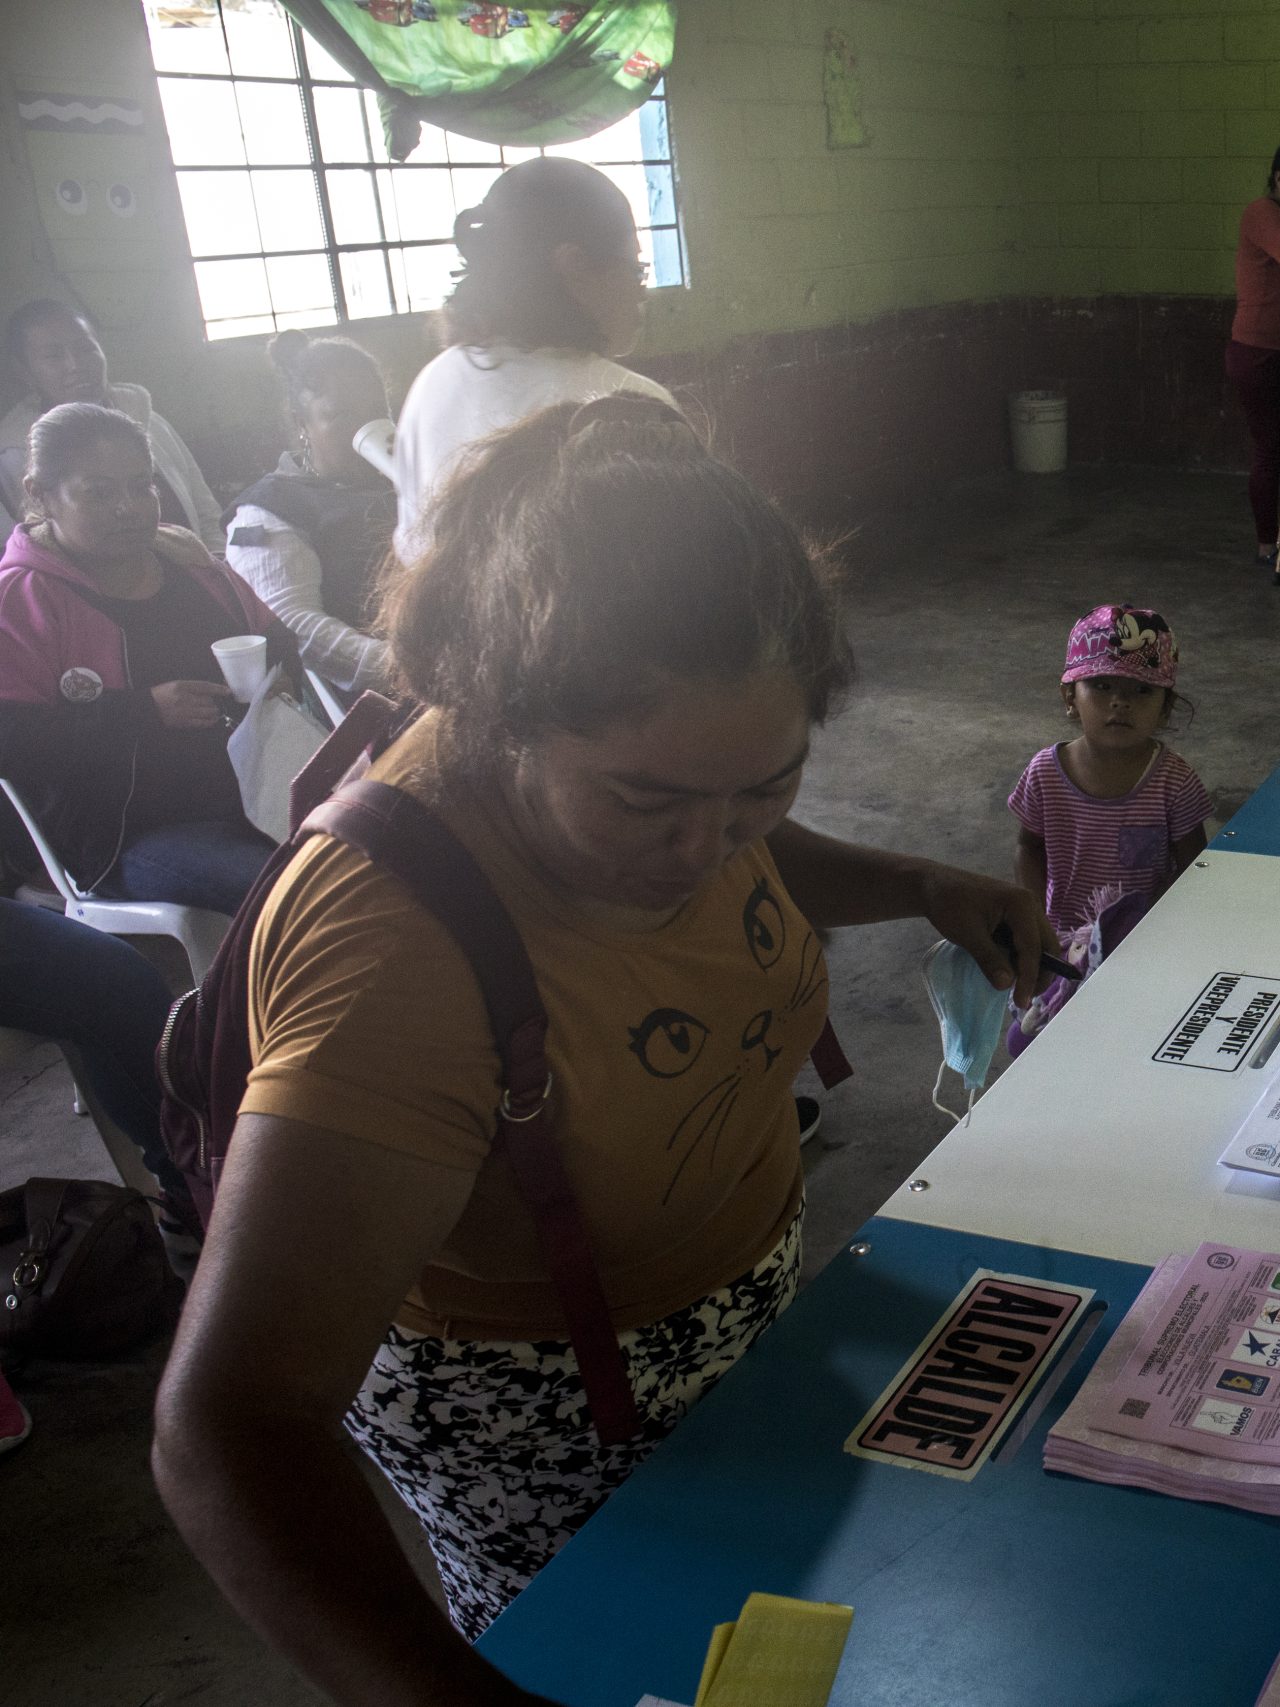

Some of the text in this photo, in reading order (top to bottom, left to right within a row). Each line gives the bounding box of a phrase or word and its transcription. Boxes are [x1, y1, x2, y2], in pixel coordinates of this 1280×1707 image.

[1161, 976, 1240, 1061] VICEPRESIDENTE
[1215, 1016, 1238, 1024] Y
[1217, 991, 1278, 1055] PRESIDENTE
[1136, 1281, 1200, 1377] TRIBUNAL SUPREMO ELECTORAL
[872, 1286, 1064, 1460] ALCALDE
[1229, 1406, 1252, 1436] VAMOS
